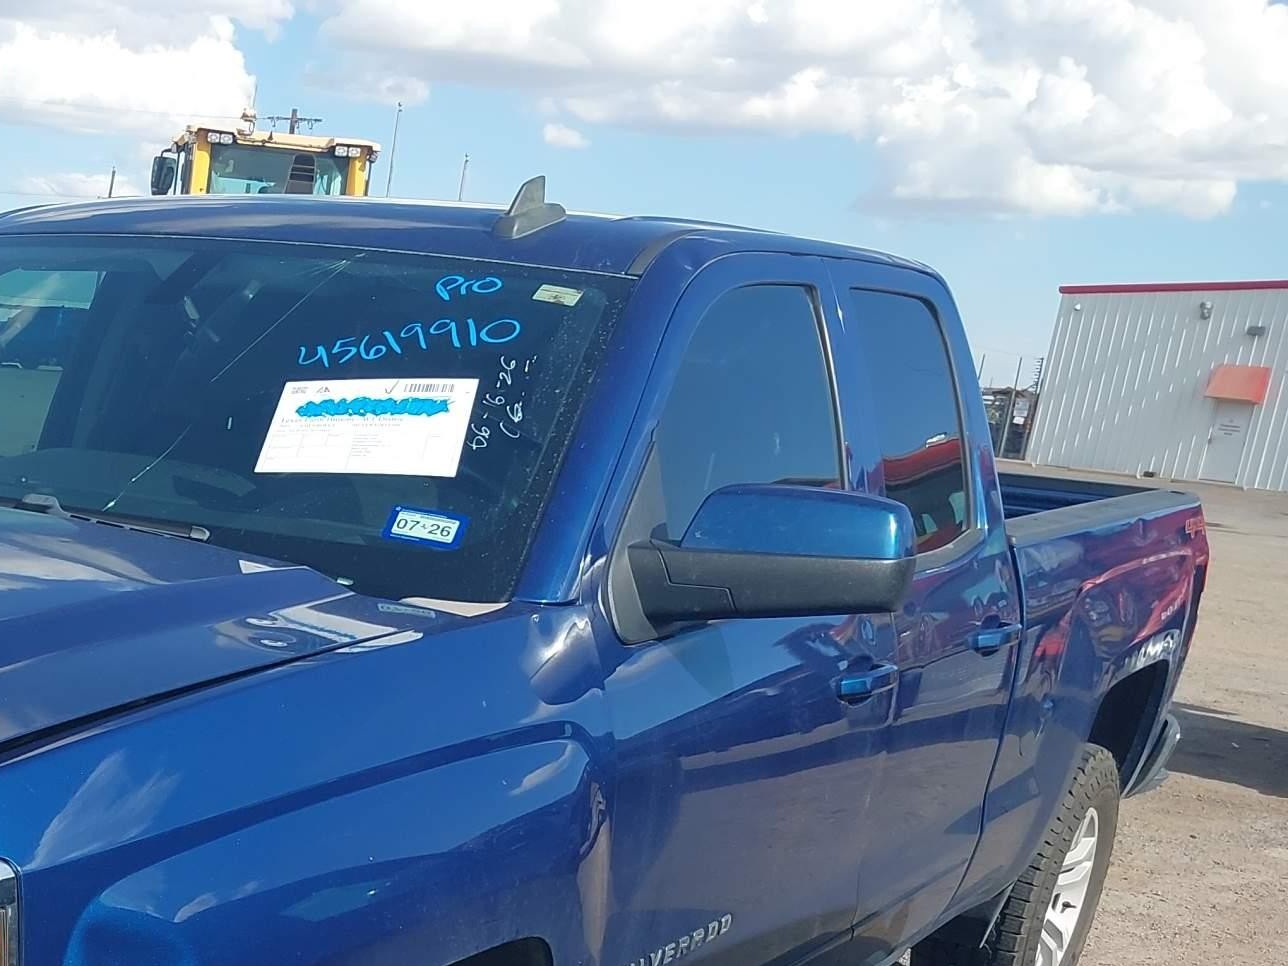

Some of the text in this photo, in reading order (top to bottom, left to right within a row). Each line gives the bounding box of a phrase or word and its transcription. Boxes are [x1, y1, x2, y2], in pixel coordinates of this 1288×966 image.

[297, 317, 521, 368] 45619910
[396, 518, 420, 531] 07
[427, 523, 452, 537] 26
